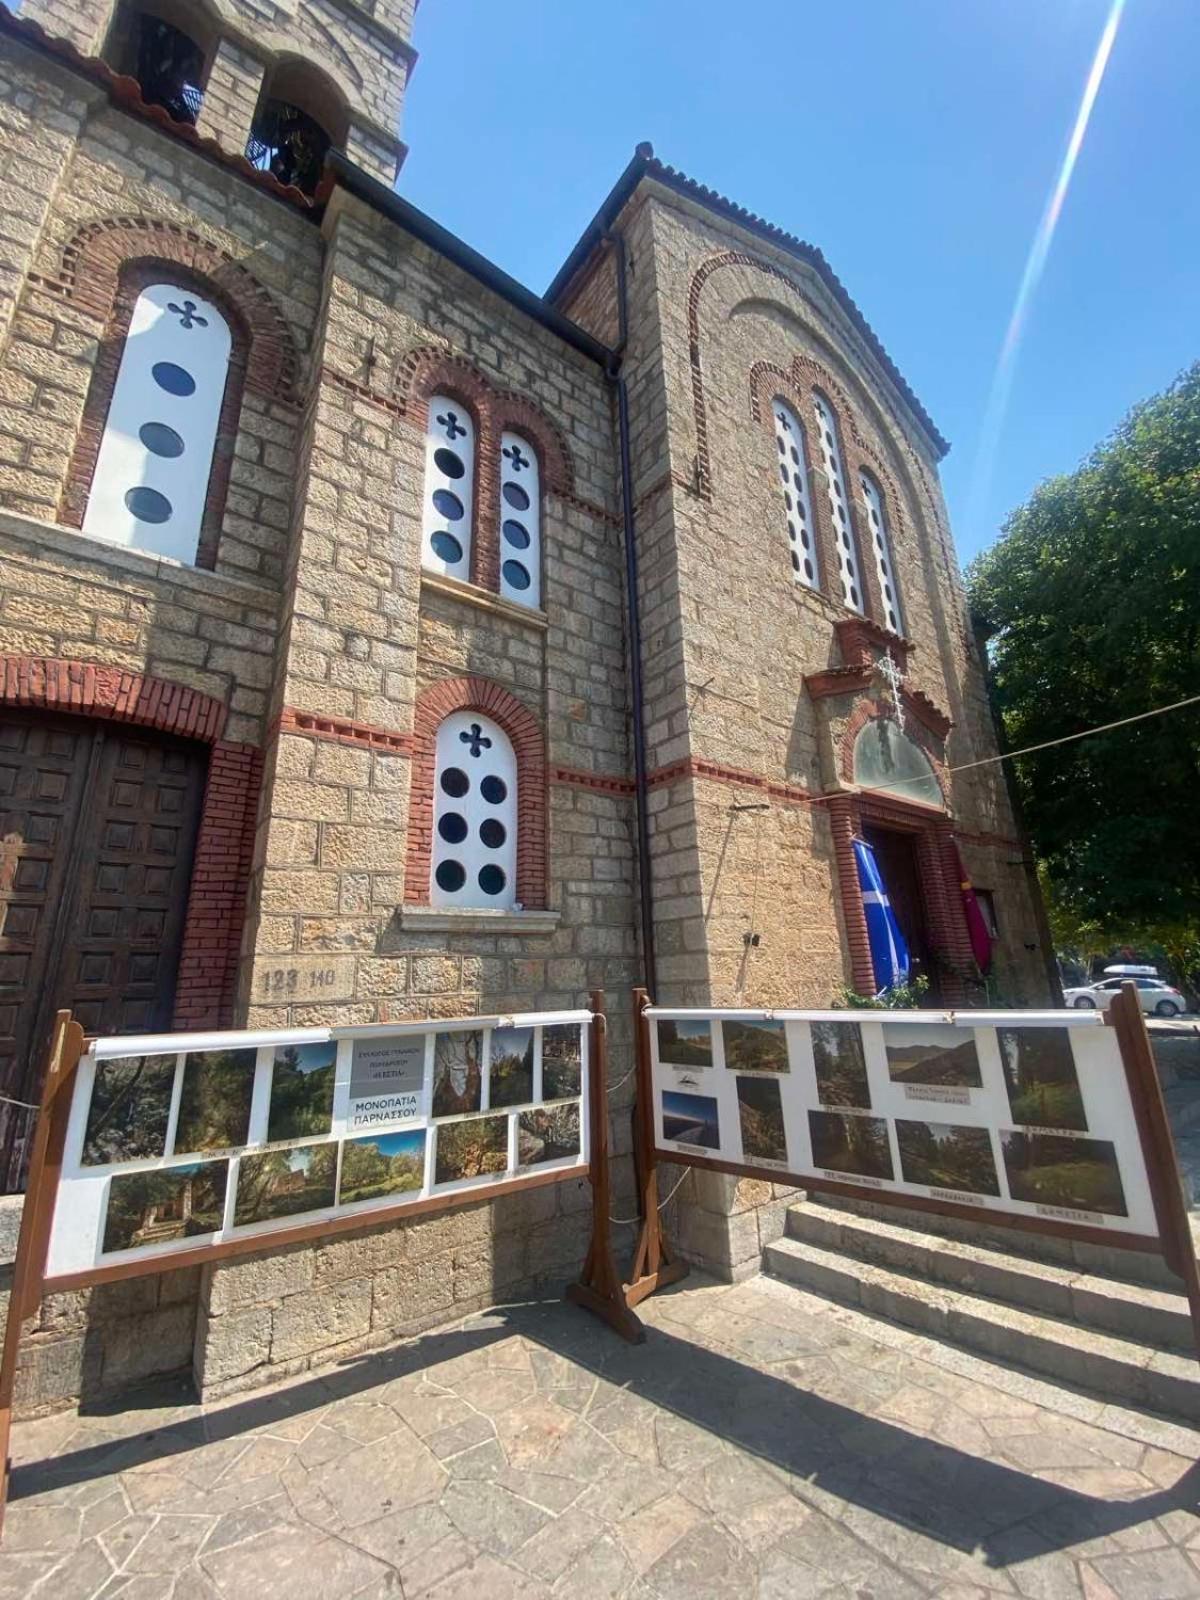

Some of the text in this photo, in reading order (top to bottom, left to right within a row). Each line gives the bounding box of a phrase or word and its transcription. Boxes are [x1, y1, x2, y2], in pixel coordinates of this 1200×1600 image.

[263, 969, 298, 993] 123
[355, 1096, 417, 1112] ΜΟΝΟΠΑΤΙΑ
[354, 1108, 417, 1125] ΠΑΡΝΑΣΣΟΥ
